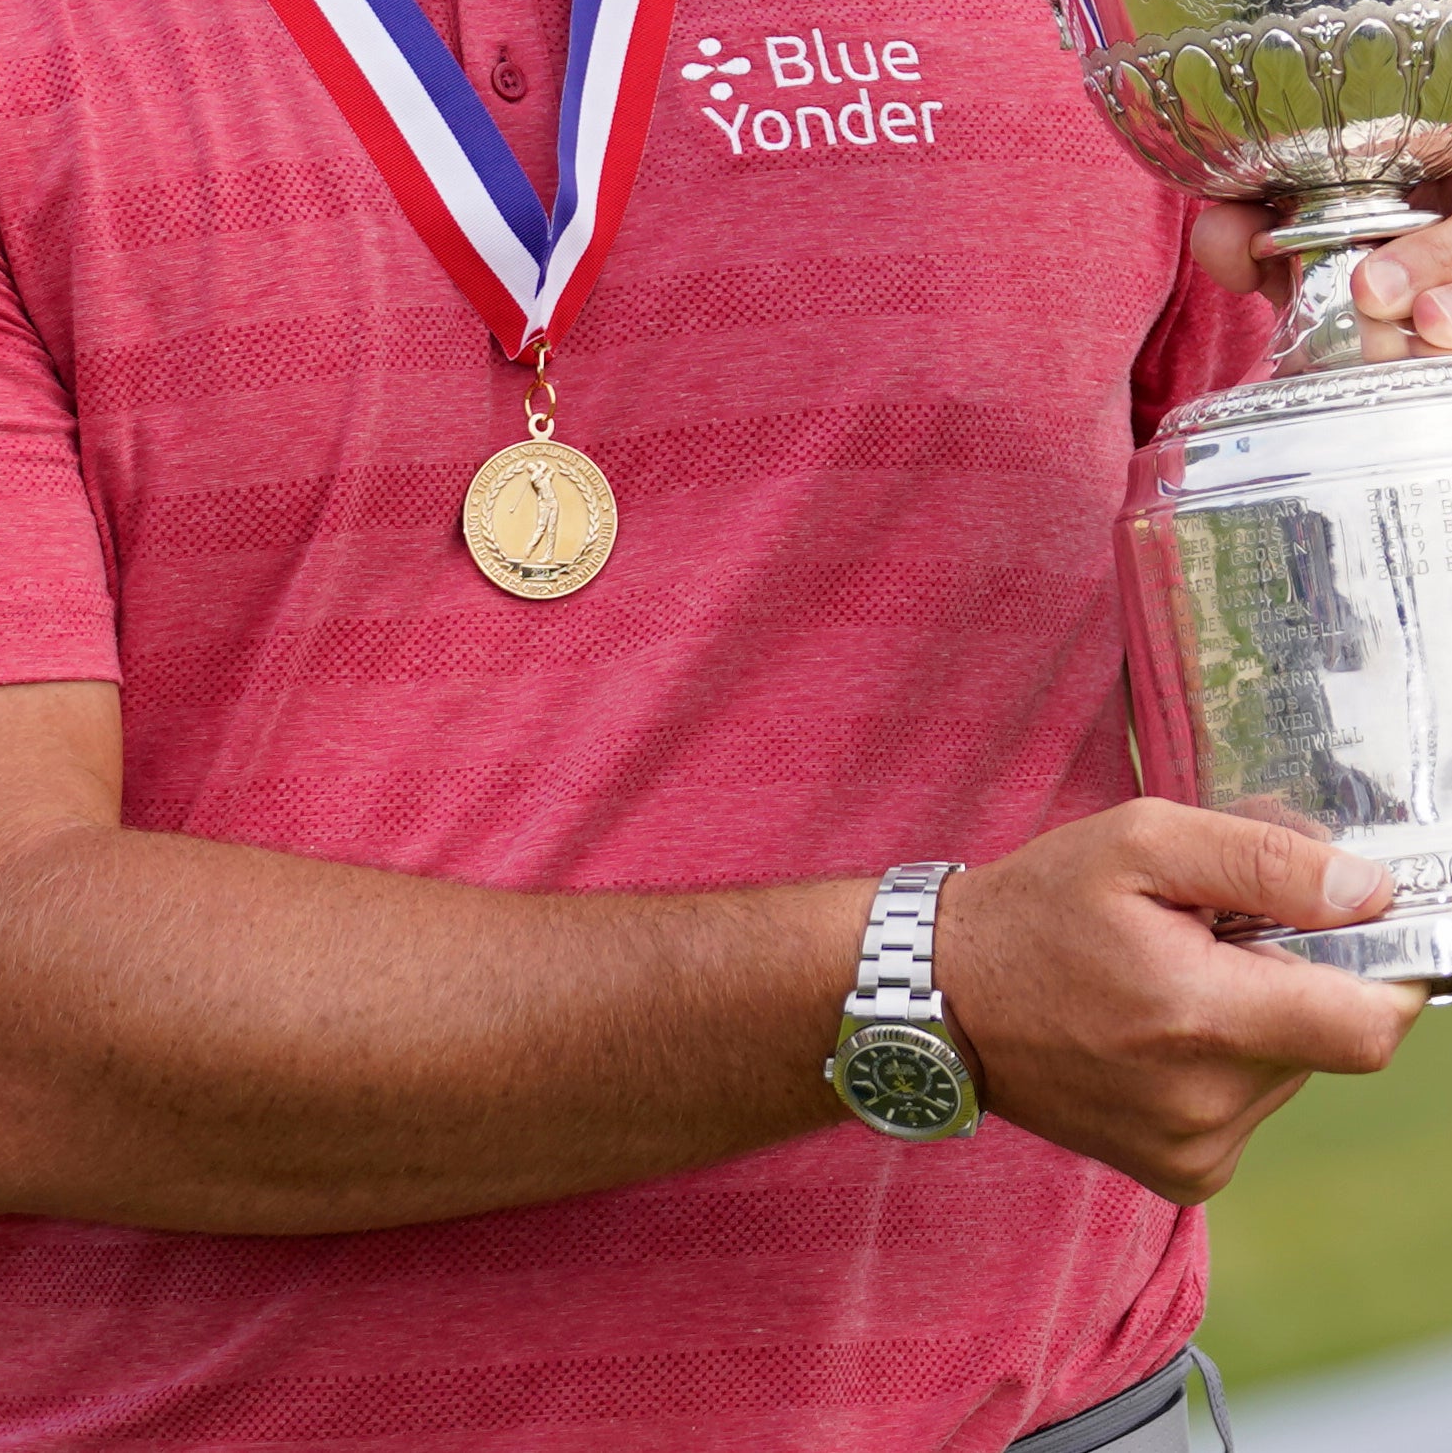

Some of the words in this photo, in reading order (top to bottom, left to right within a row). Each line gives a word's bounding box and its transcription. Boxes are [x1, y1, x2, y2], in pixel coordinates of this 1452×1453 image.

[765, 28, 922, 88] Blue
[701, 88, 943, 154] Yonder
[1219, 498, 1310, 529] STEWART
[1229, 540, 1309, 567] GOOSEN
